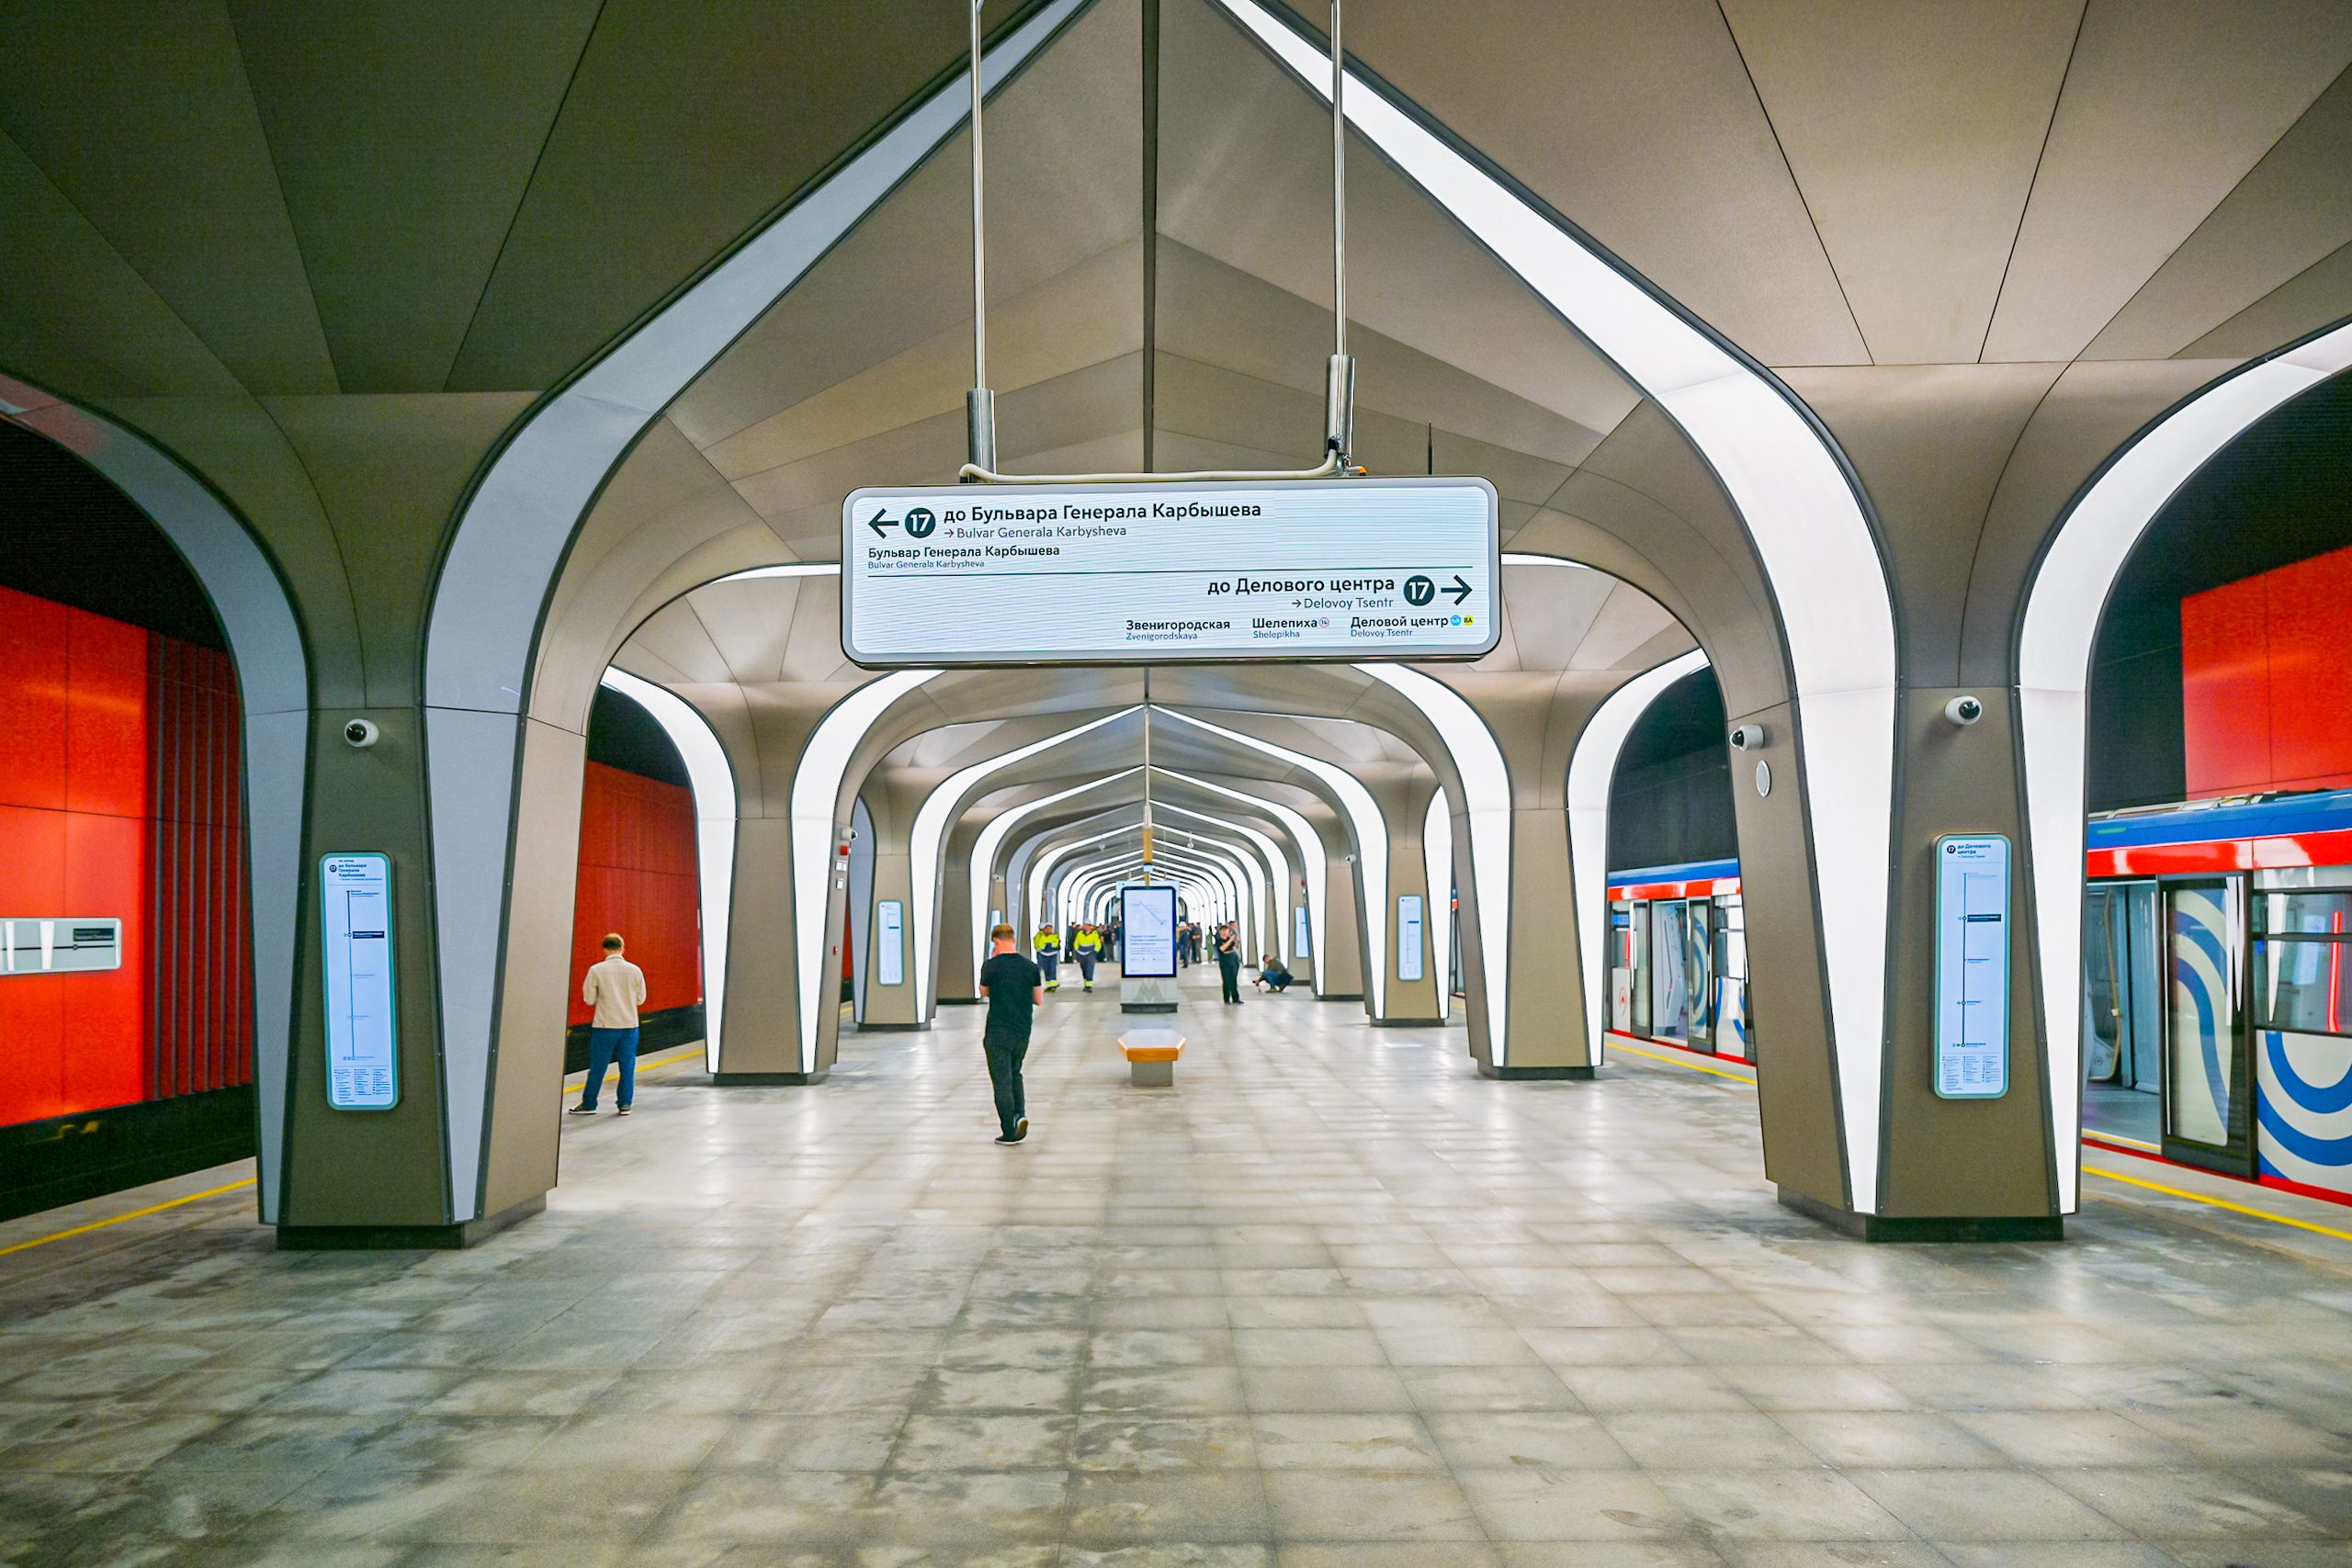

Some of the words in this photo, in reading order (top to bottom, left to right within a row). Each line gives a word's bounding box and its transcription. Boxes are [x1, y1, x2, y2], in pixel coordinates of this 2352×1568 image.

[910, 513, 931, 532] 17
[944, 510, 966, 523] до
[972, 506, 1057, 523] Бульвара
[1063, 504, 1147, 522] Генерала
[1153, 502, 1261, 521] Карбышева
[956, 527, 995, 538] Bulvar
[998, 526, 1053, 538] Generala
[1057, 525, 1126, 538] Karbysheva
[868, 547, 921, 560] Бульвар
[924, 547, 981, 558] Генерала
[985, 545, 1060, 558] Карбышева
[868, 560, 894, 570] Bulvar
[896, 559, 933, 569] Generala
[936, 559, 985, 569] Karbysheva
[1207, 581, 1230, 595] до
[1236, 578, 1325, 595] Делового
[1330, 579, 1395, 593] центра
[1408, 581, 1430, 600] 17
[1305, 598, 1352, 610] Delovoy
[1355, 597, 1394, 608] Tsentr
[1125, 619, 1231, 632] Звенигородская
[1252, 617, 1317, 629] Шелепиха
[1351, 615, 1407, 628] Деловой
[1410, 617, 1449, 629] центр
[1125, 632, 1198, 642] Zvenigorodskaya
[1253, 630, 1300, 639] Shelepikha
[1351, 629, 1385, 638] Delovoy
[1387, 629, 1413, 637] Tsentr
